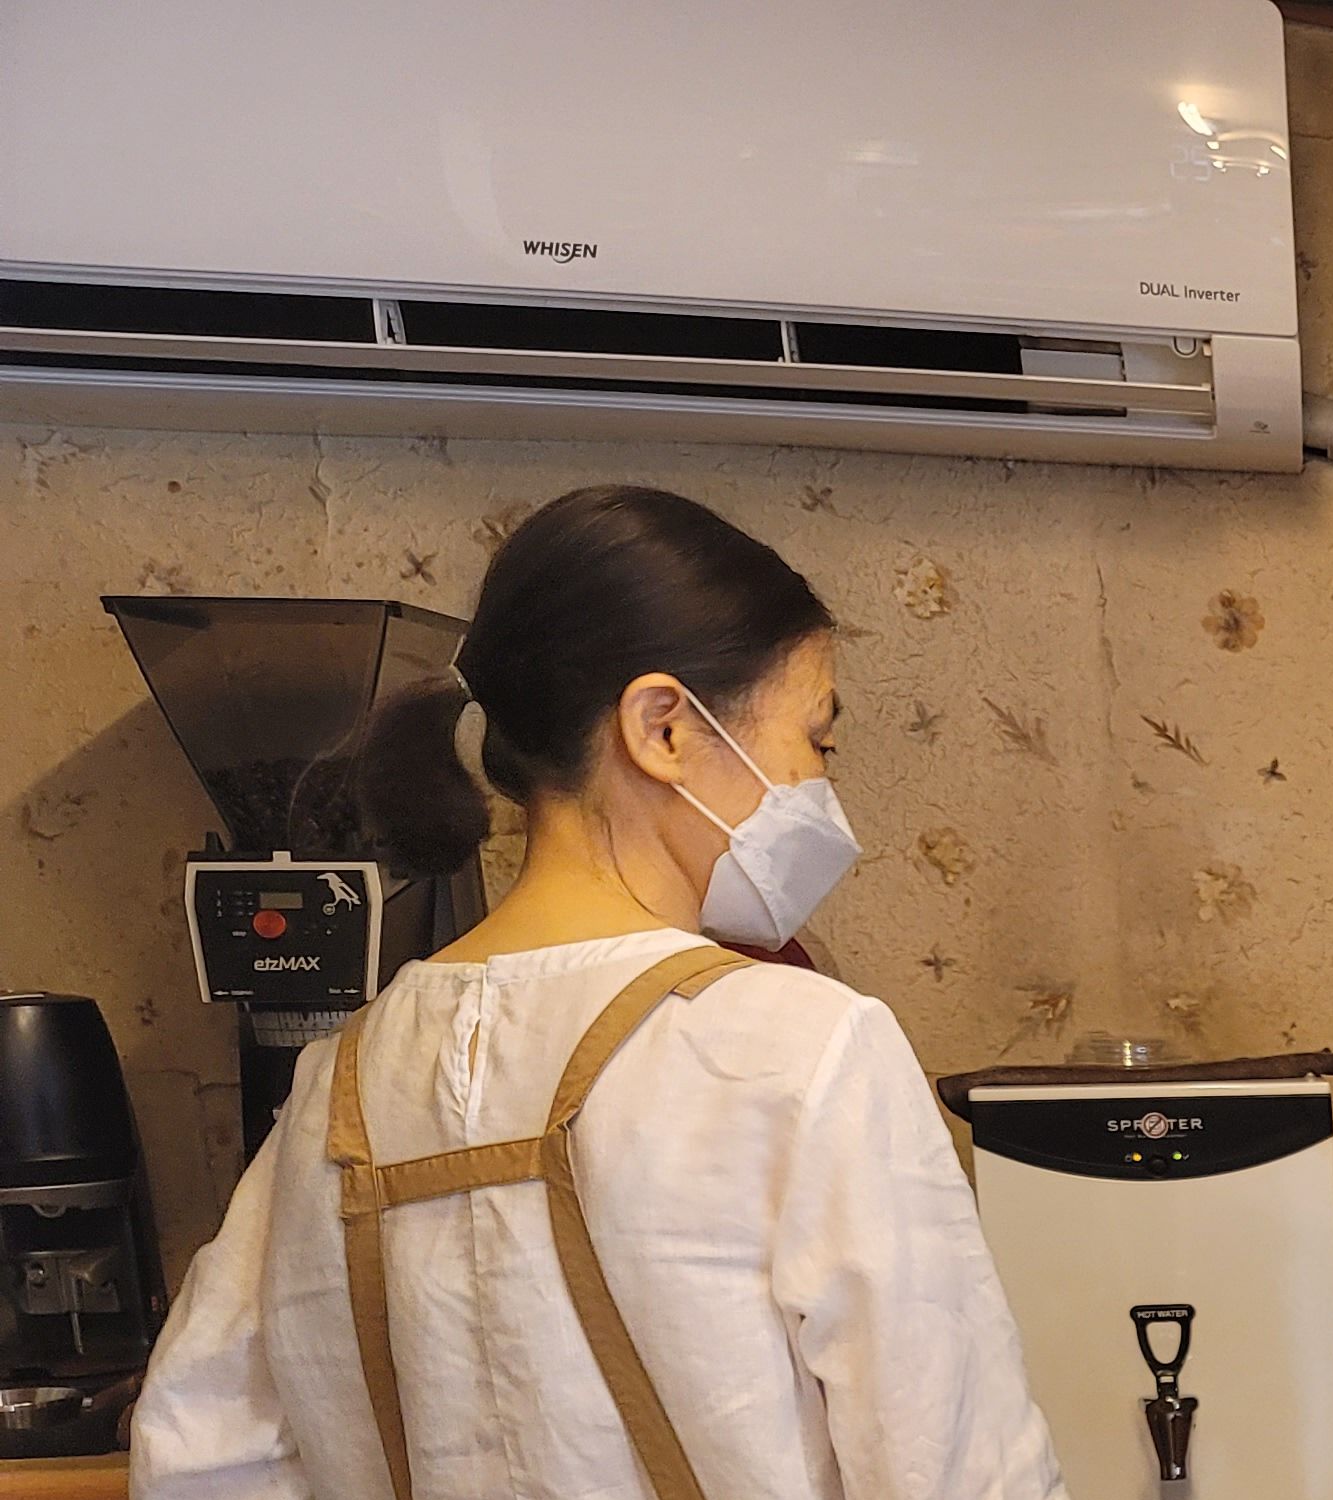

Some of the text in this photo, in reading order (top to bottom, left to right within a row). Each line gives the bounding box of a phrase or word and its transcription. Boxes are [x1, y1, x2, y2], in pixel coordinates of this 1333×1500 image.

[522, 239, 598, 263] WHISEN
[1139, 281, 1241, 302] DUAL Inverter
[253, 956, 321, 972] etzMAX
[1136, 1309, 1189, 1319] HOT WATER
